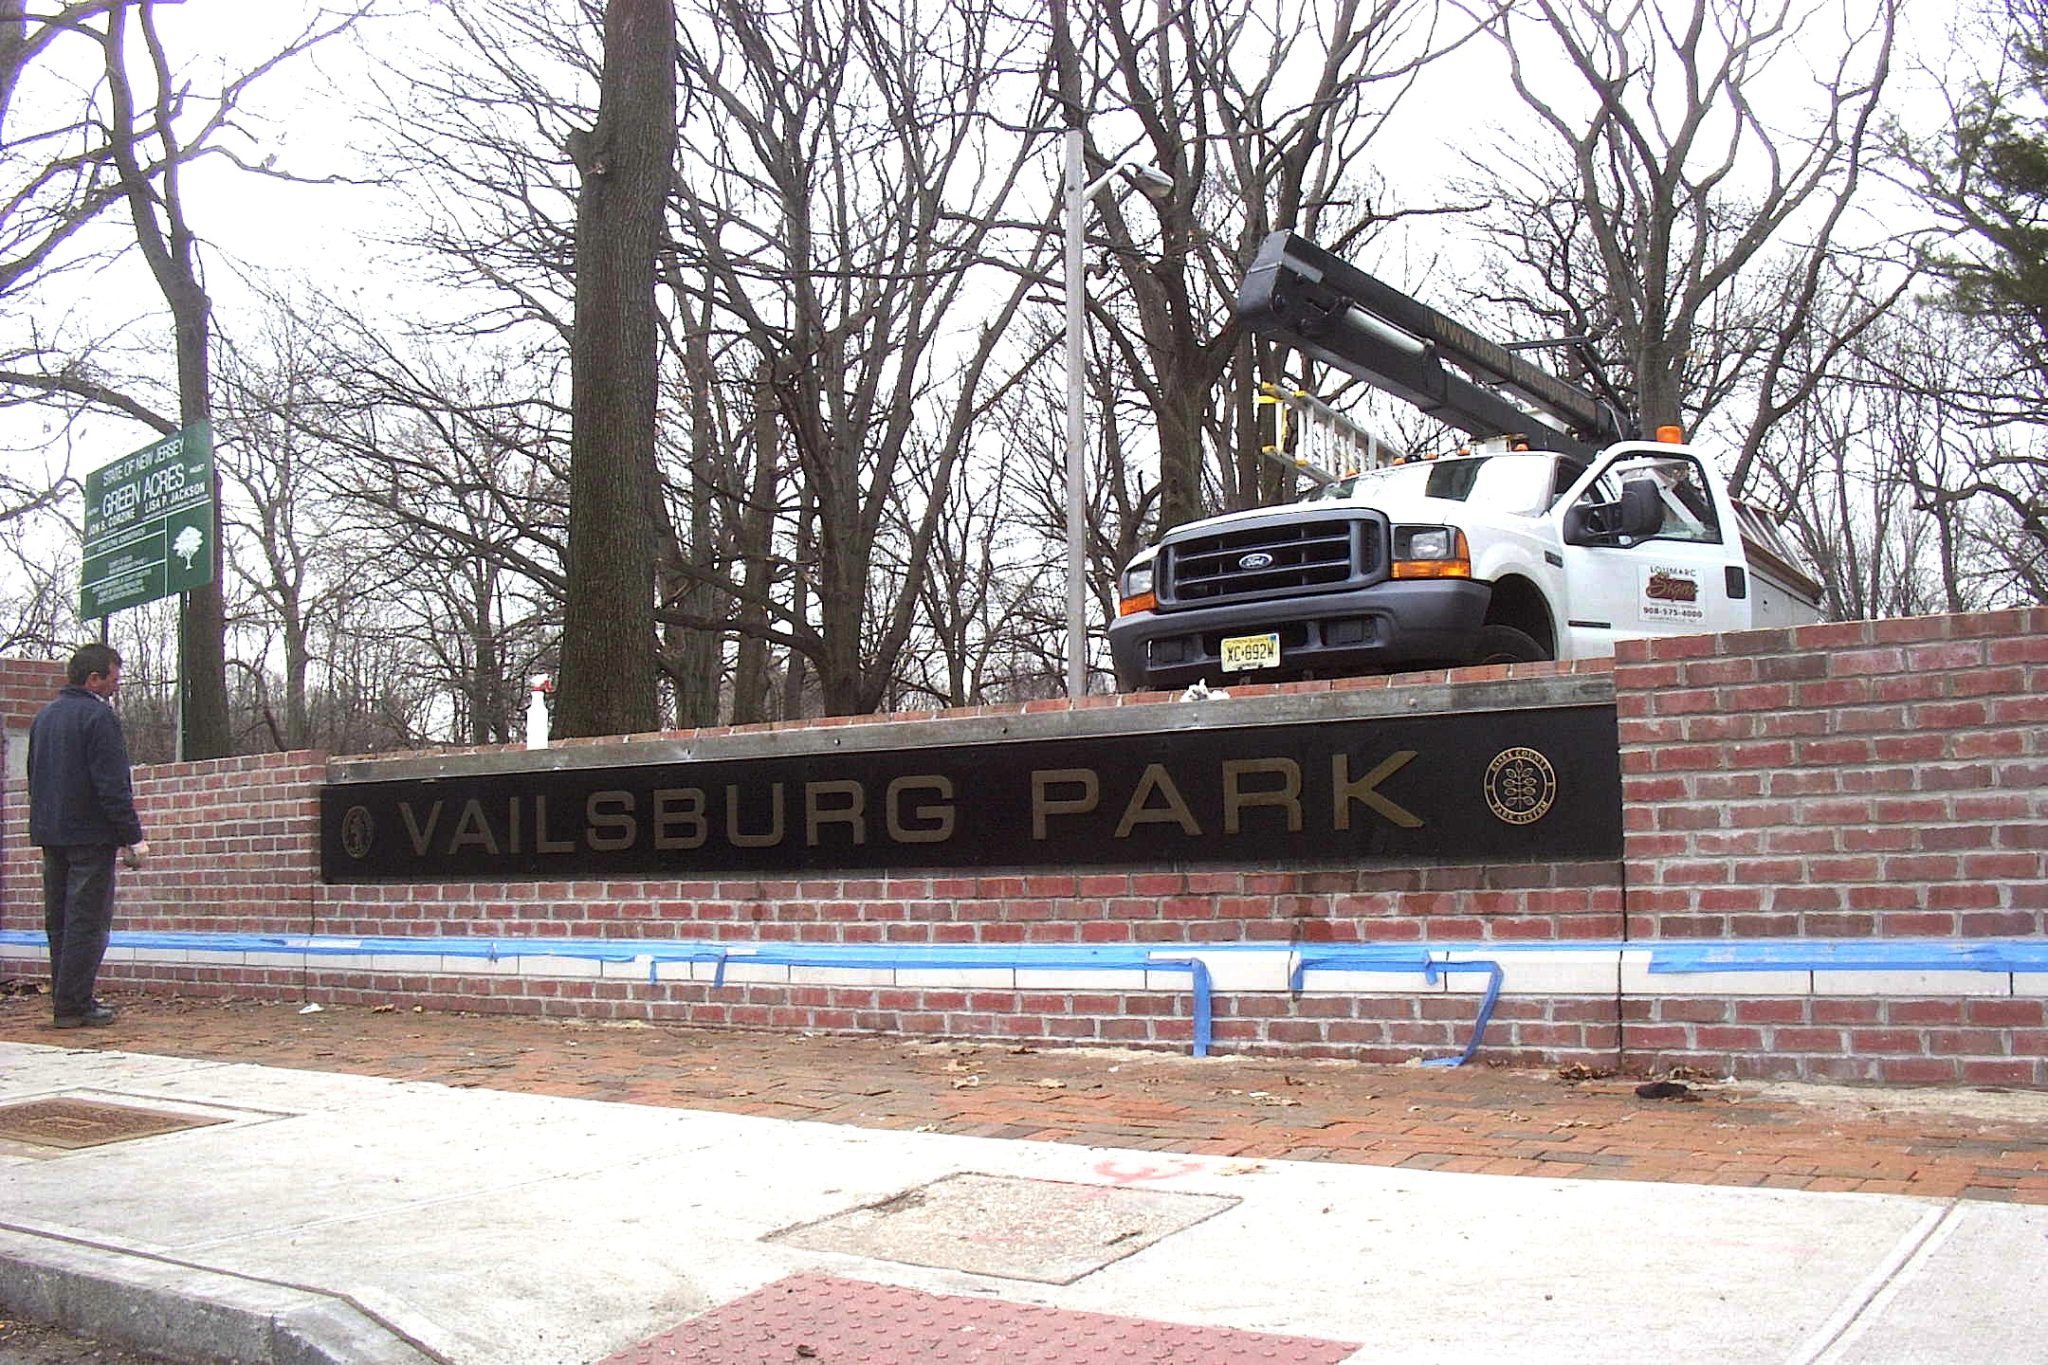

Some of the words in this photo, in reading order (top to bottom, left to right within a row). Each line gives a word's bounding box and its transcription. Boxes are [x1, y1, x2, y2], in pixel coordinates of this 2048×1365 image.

[103, 464, 123, 487] STATE
[124, 459, 135, 477] OF
[136, 451, 154, 471] NEW
[154, 438, 184, 464] JERSEY
[103, 480, 141, 518] GREEN
[143, 463, 185, 501] ACRES
[145, 499, 161, 514] LISA
[170, 482, 206, 504] JACKSON
[400, 774, 956, 856] VAILSBURG
[1031, 750, 1425, 841] PARK
